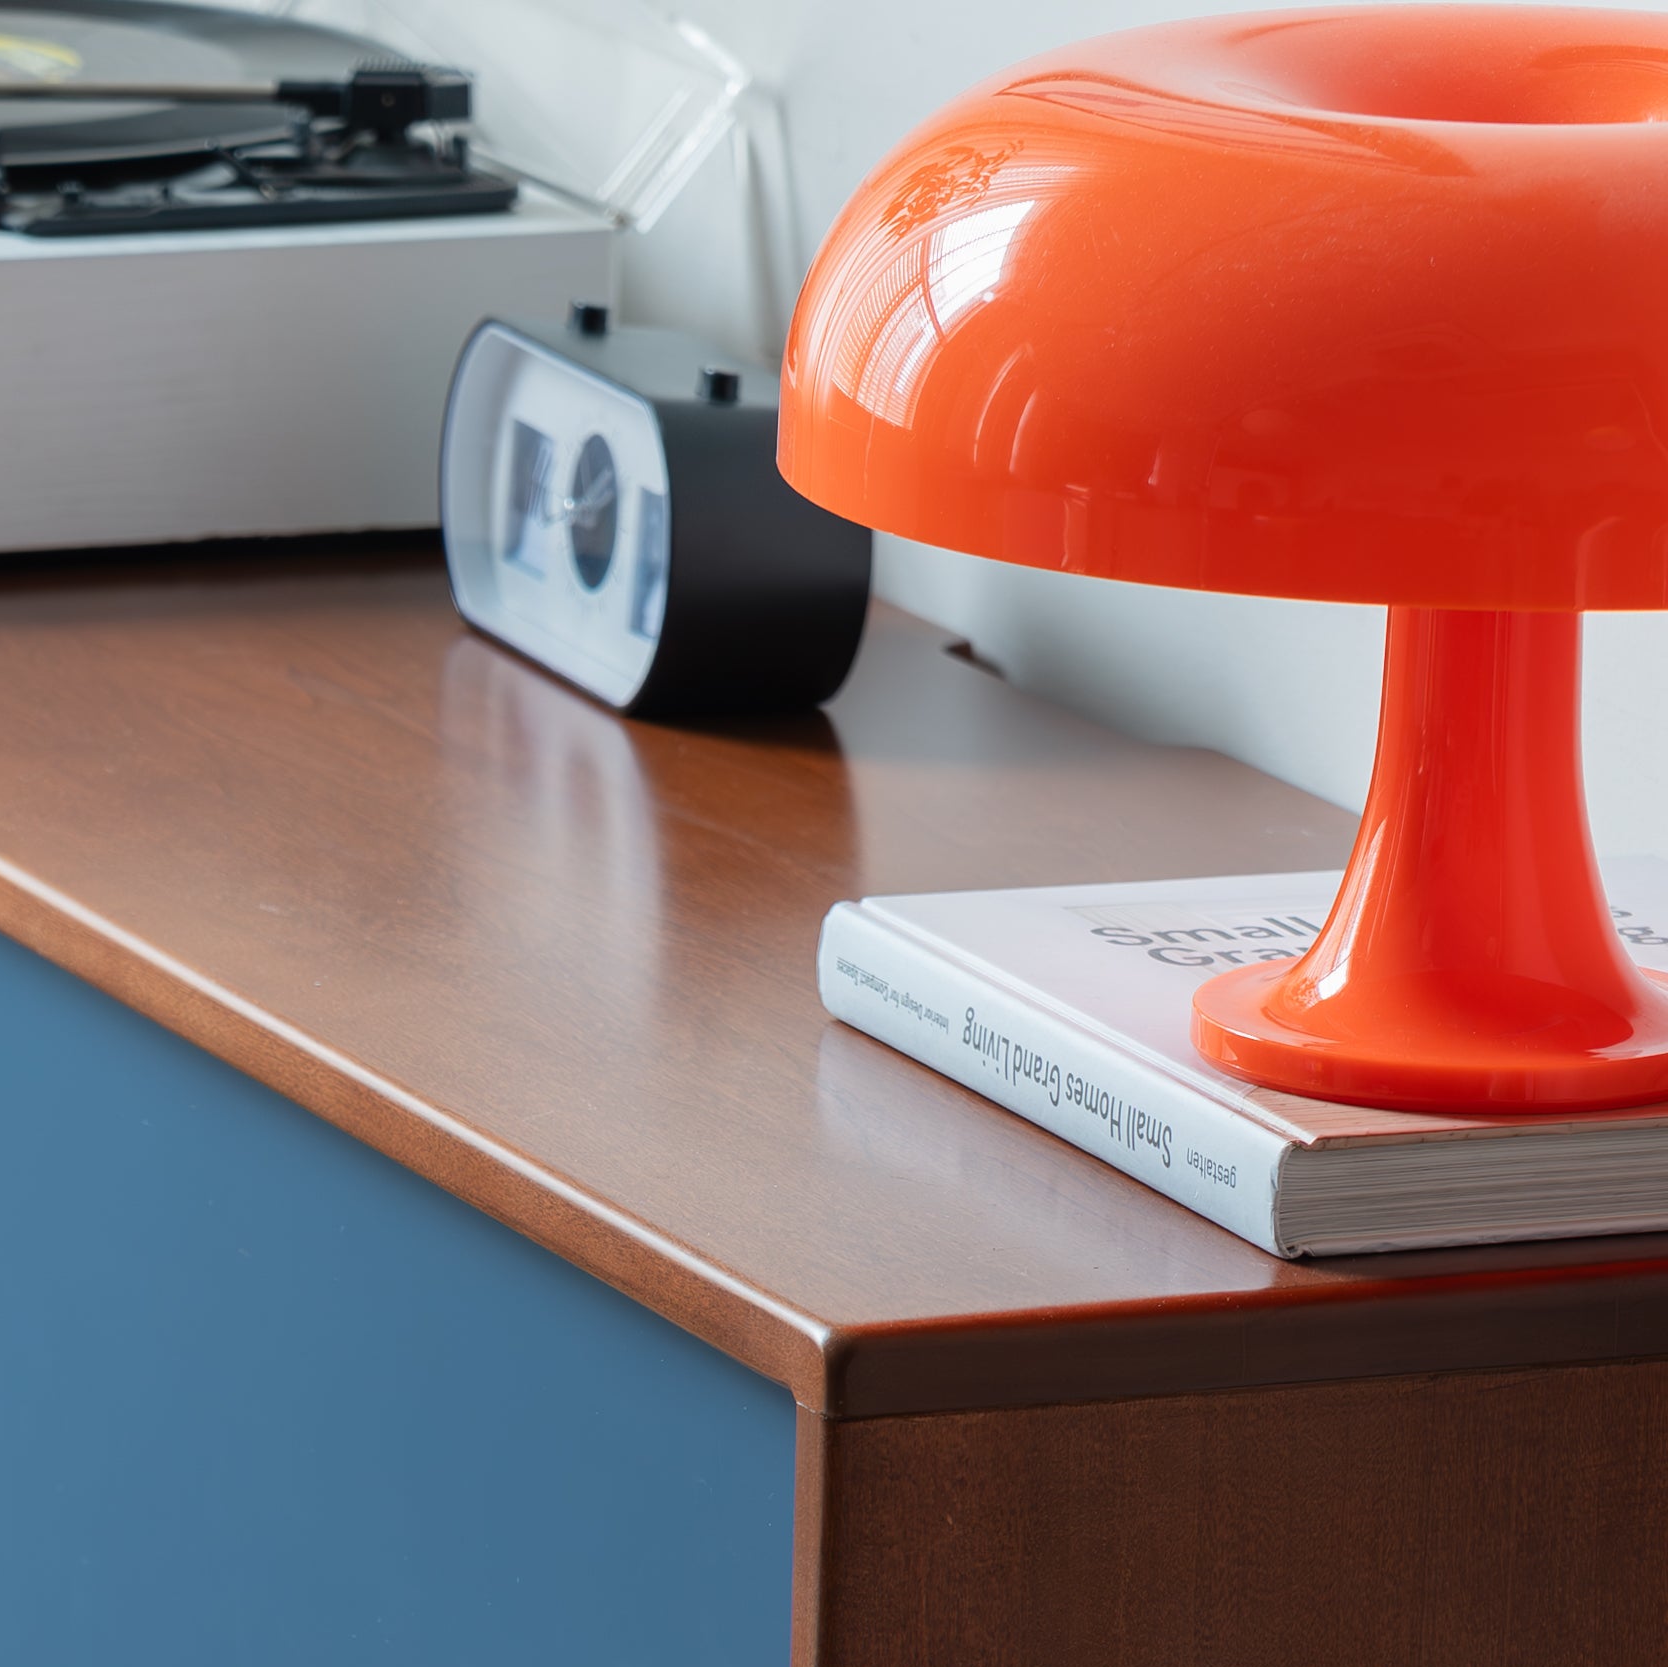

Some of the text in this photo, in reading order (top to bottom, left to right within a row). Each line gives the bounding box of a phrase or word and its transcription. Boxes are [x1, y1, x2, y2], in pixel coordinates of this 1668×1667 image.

[1090, 915, 1323, 946] Small
[836, 959, 950, 1035] Interior Design for Compact Spaces
[962, 1006, 1172, 1169] Small Homes Grand Living
[1186, 1147, 1237, 1188] gestalten
